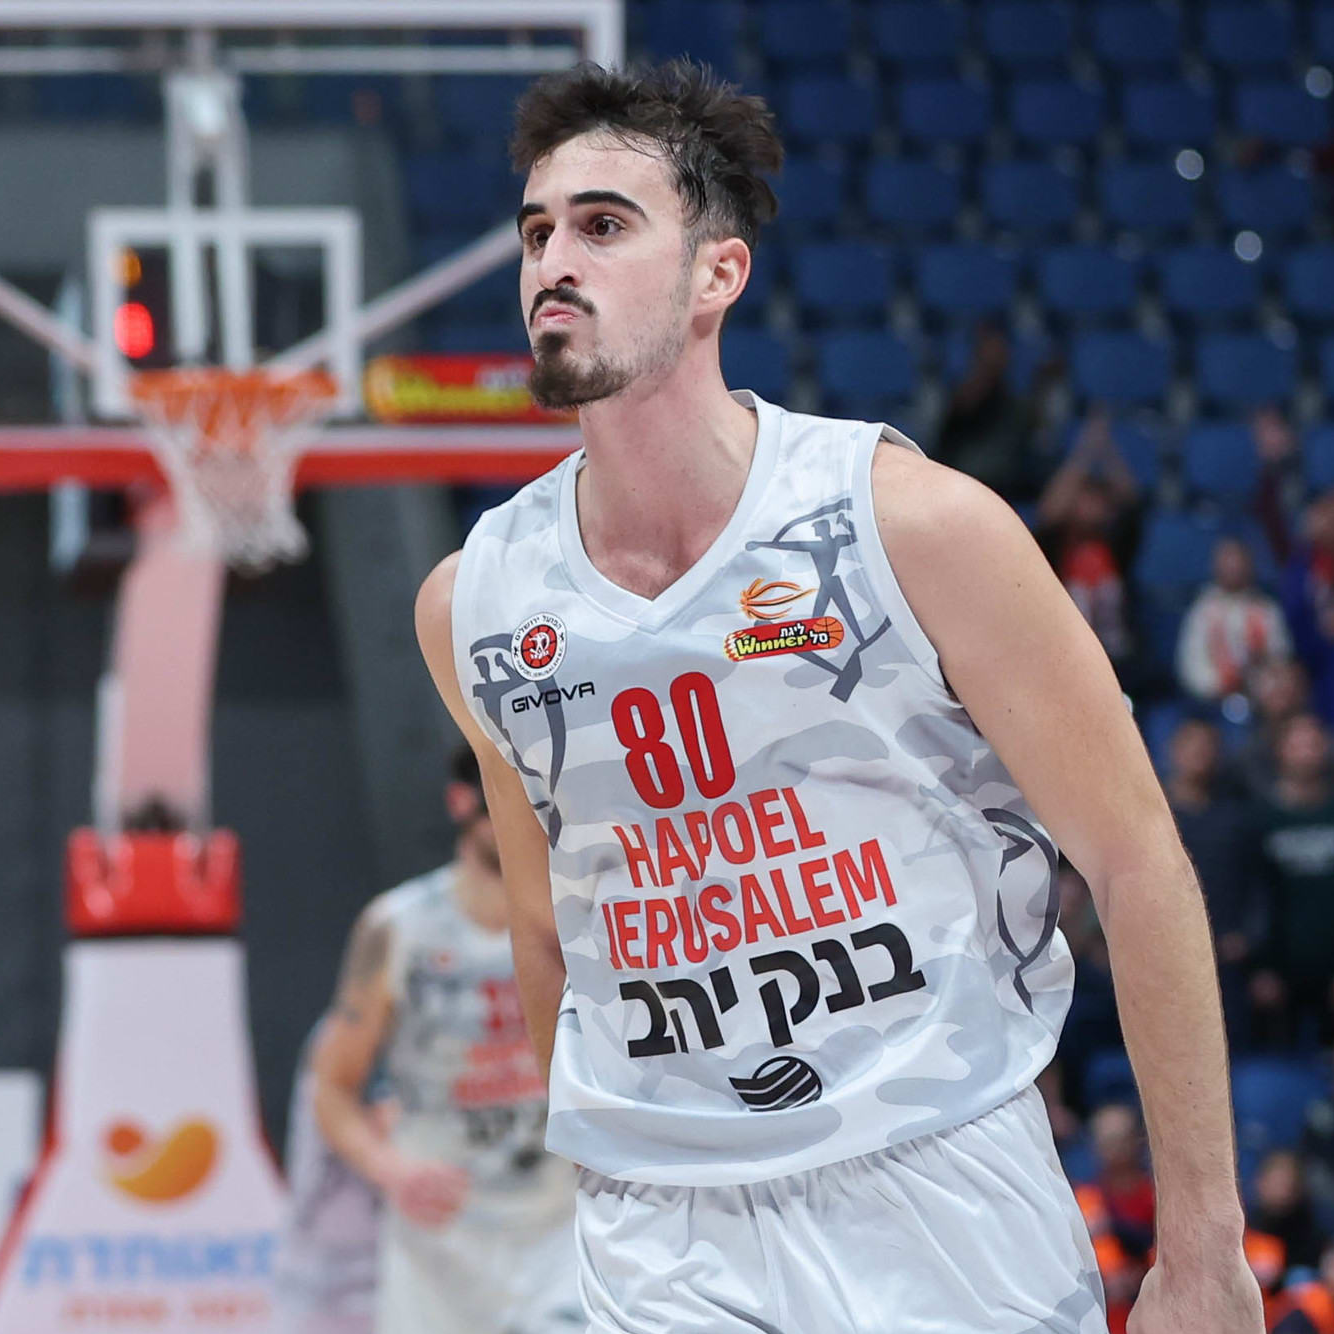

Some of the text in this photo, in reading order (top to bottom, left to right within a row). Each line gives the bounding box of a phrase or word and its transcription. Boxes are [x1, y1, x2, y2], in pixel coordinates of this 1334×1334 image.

[736, 634, 808, 656] Winner
[511, 681, 596, 714] GIVOVA
[611, 671, 736, 809] 80
[612, 787, 826, 888] HAPOEL
[618, 922, 927, 1059] בנק יהב
